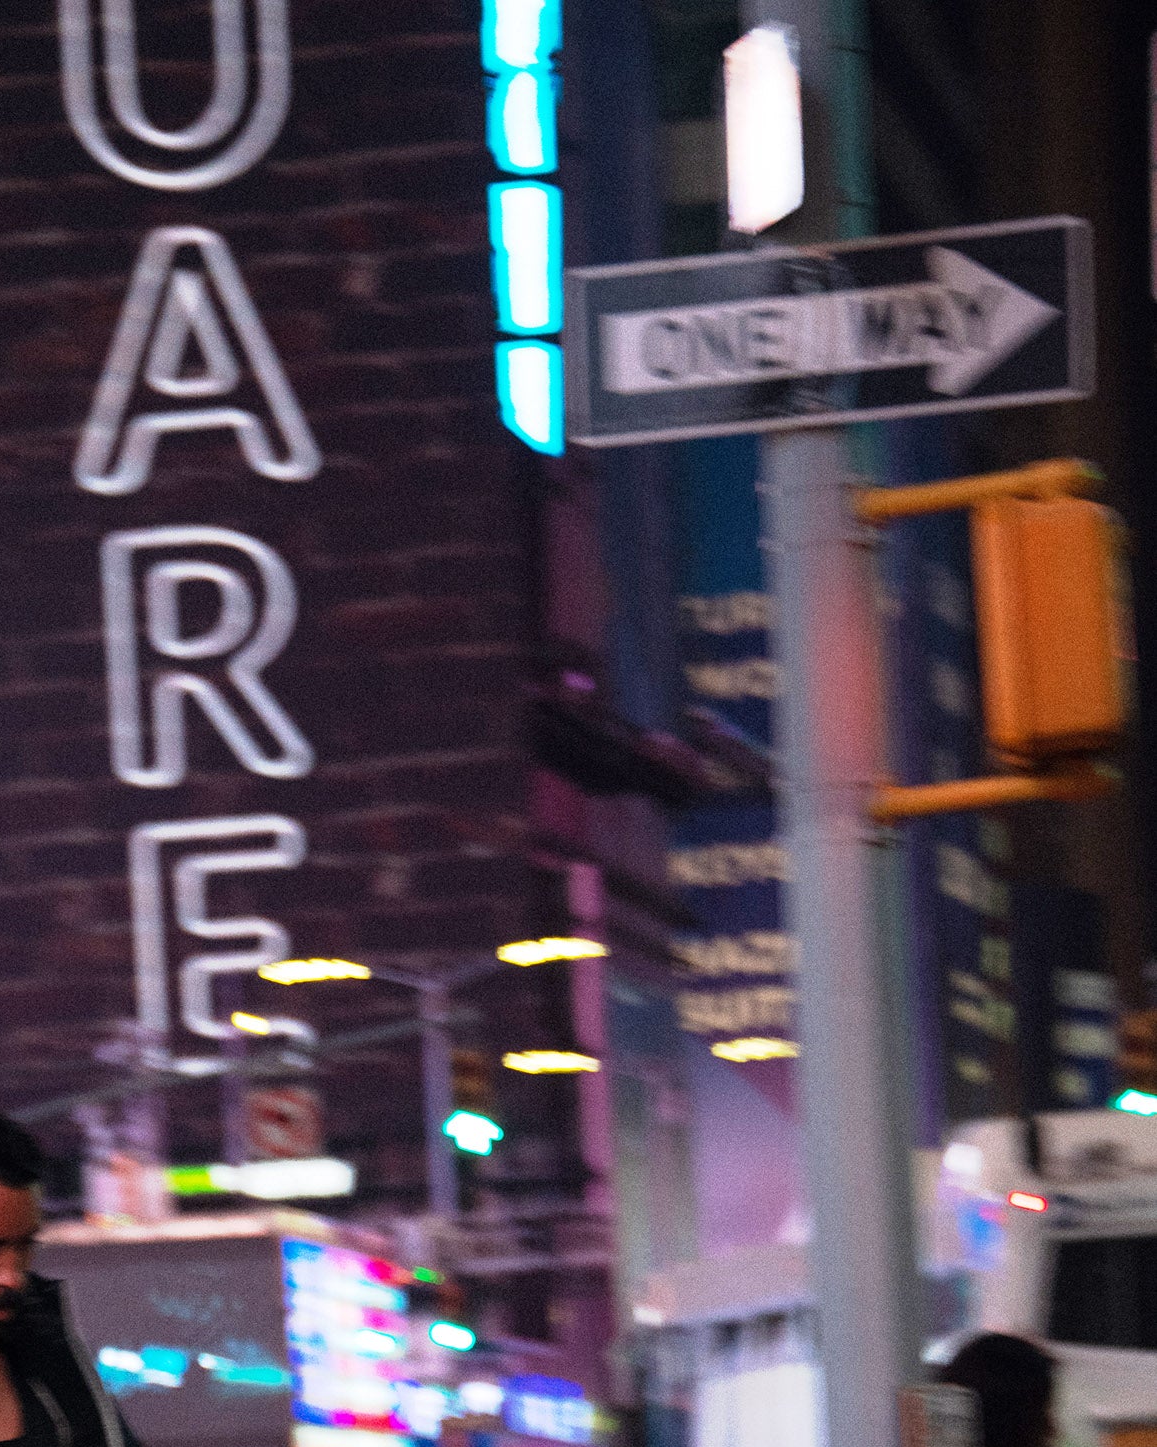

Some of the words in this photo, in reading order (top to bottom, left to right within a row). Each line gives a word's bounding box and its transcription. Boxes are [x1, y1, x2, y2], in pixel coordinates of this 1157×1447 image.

[58, 0, 322, 1077] UARE
[644, 302, 794, 386] ONE
[856, 280, 1018, 360] WAY
